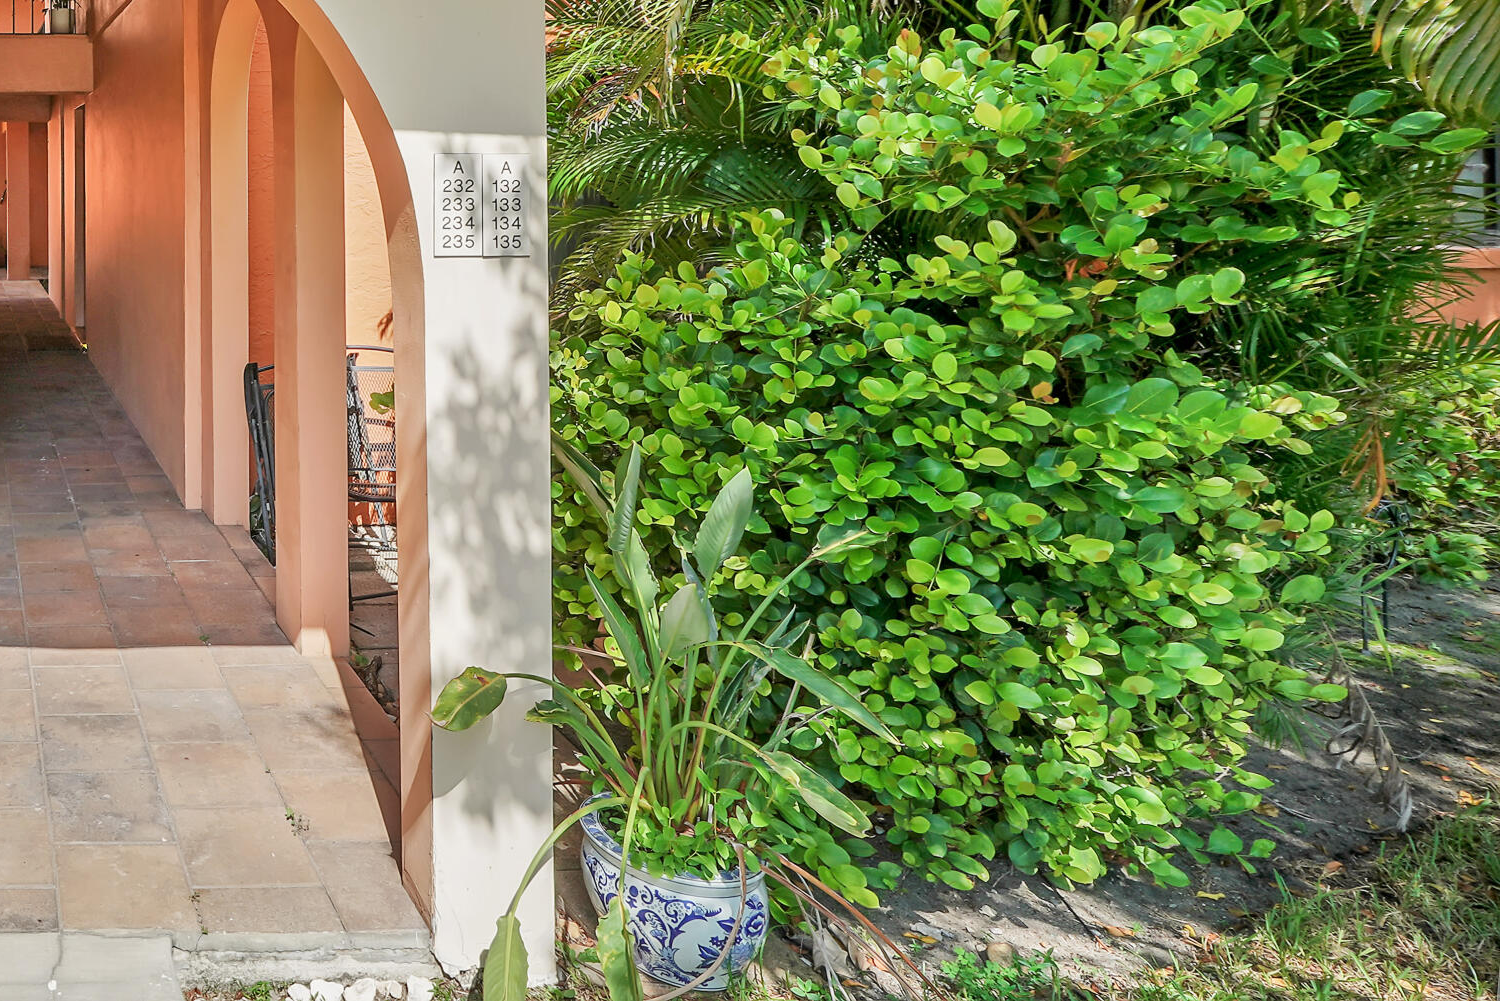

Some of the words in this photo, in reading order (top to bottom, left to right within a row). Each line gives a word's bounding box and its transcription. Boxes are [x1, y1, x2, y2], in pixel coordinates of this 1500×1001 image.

[453, 160, 464, 174] A
[501, 161, 512, 174] A
[443, 179, 475, 193] 232
[492, 179, 521, 193] 132
[442, 197, 475, 212] 233
[491, 198, 522, 212] 133
[442, 216, 476, 230] 234
[491, 216, 522, 230] 134
[442, 234, 475, 249] 235
[492, 235, 522, 249] 135
